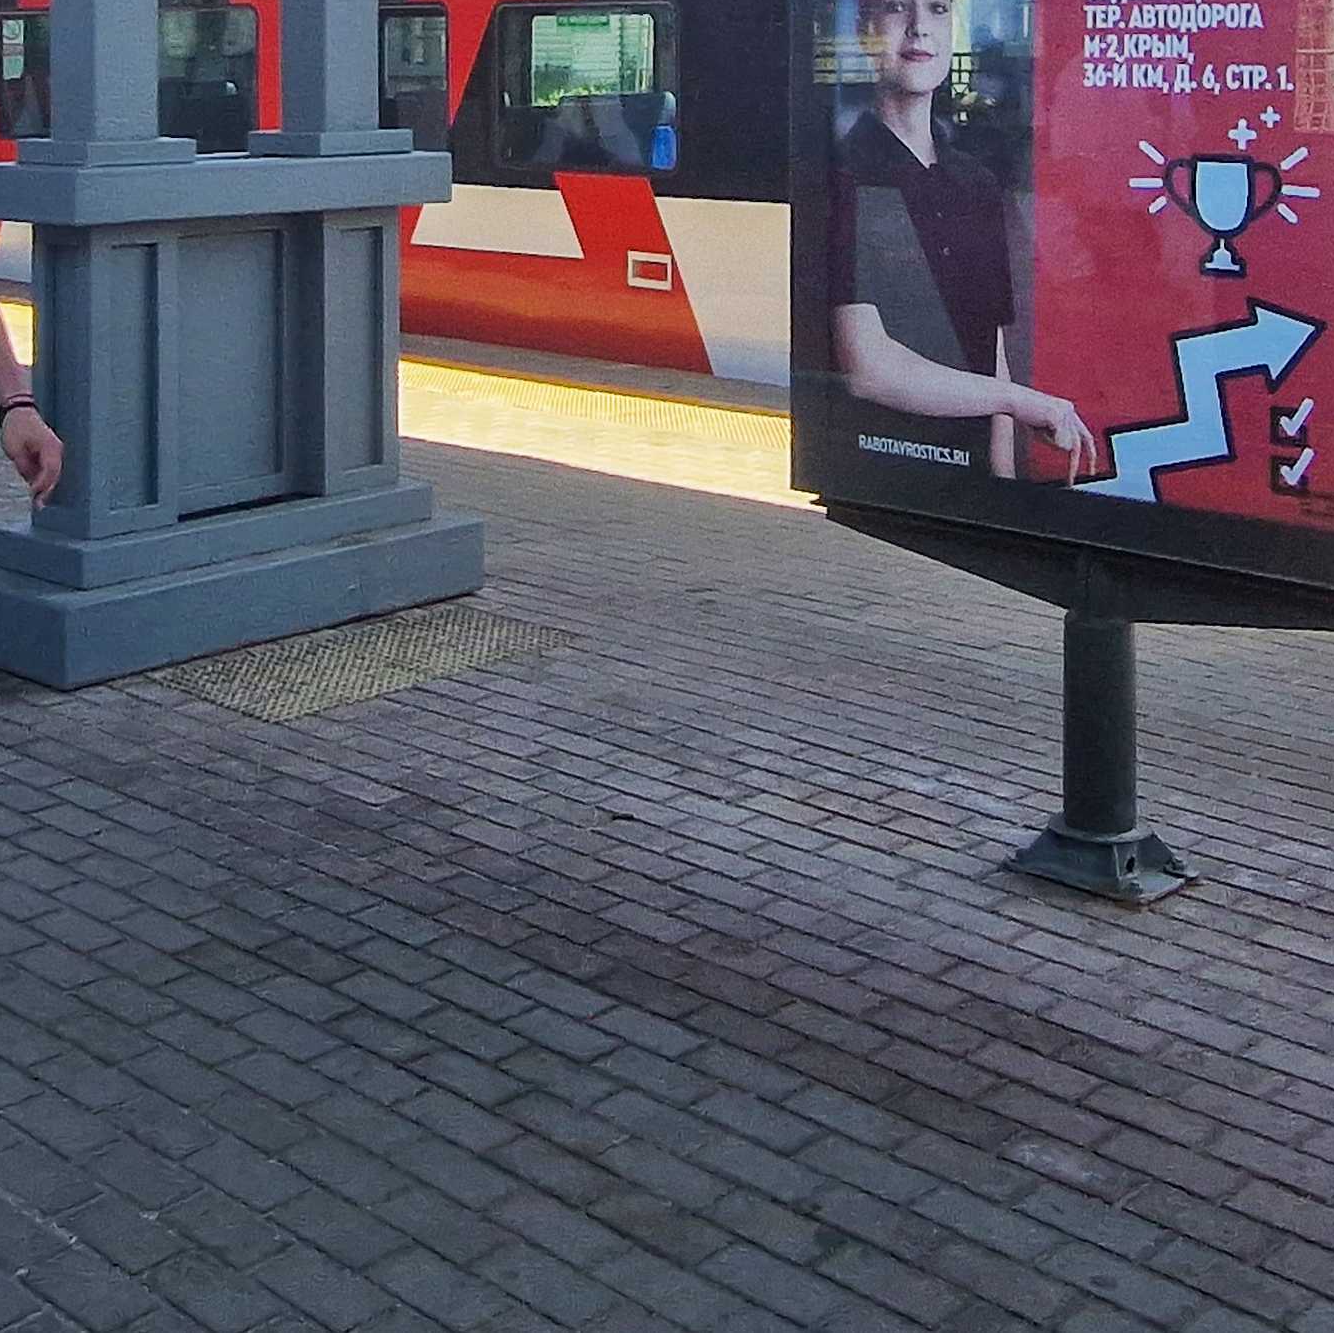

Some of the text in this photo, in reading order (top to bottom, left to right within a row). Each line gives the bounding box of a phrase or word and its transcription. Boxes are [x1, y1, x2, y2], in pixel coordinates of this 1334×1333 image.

[1083, 3, 1264, 33] ТЕР. АВТОДОРОГА
[1082, 53, 1295, 95] 36-Й КМ, Д. 6, СТР. 1.
